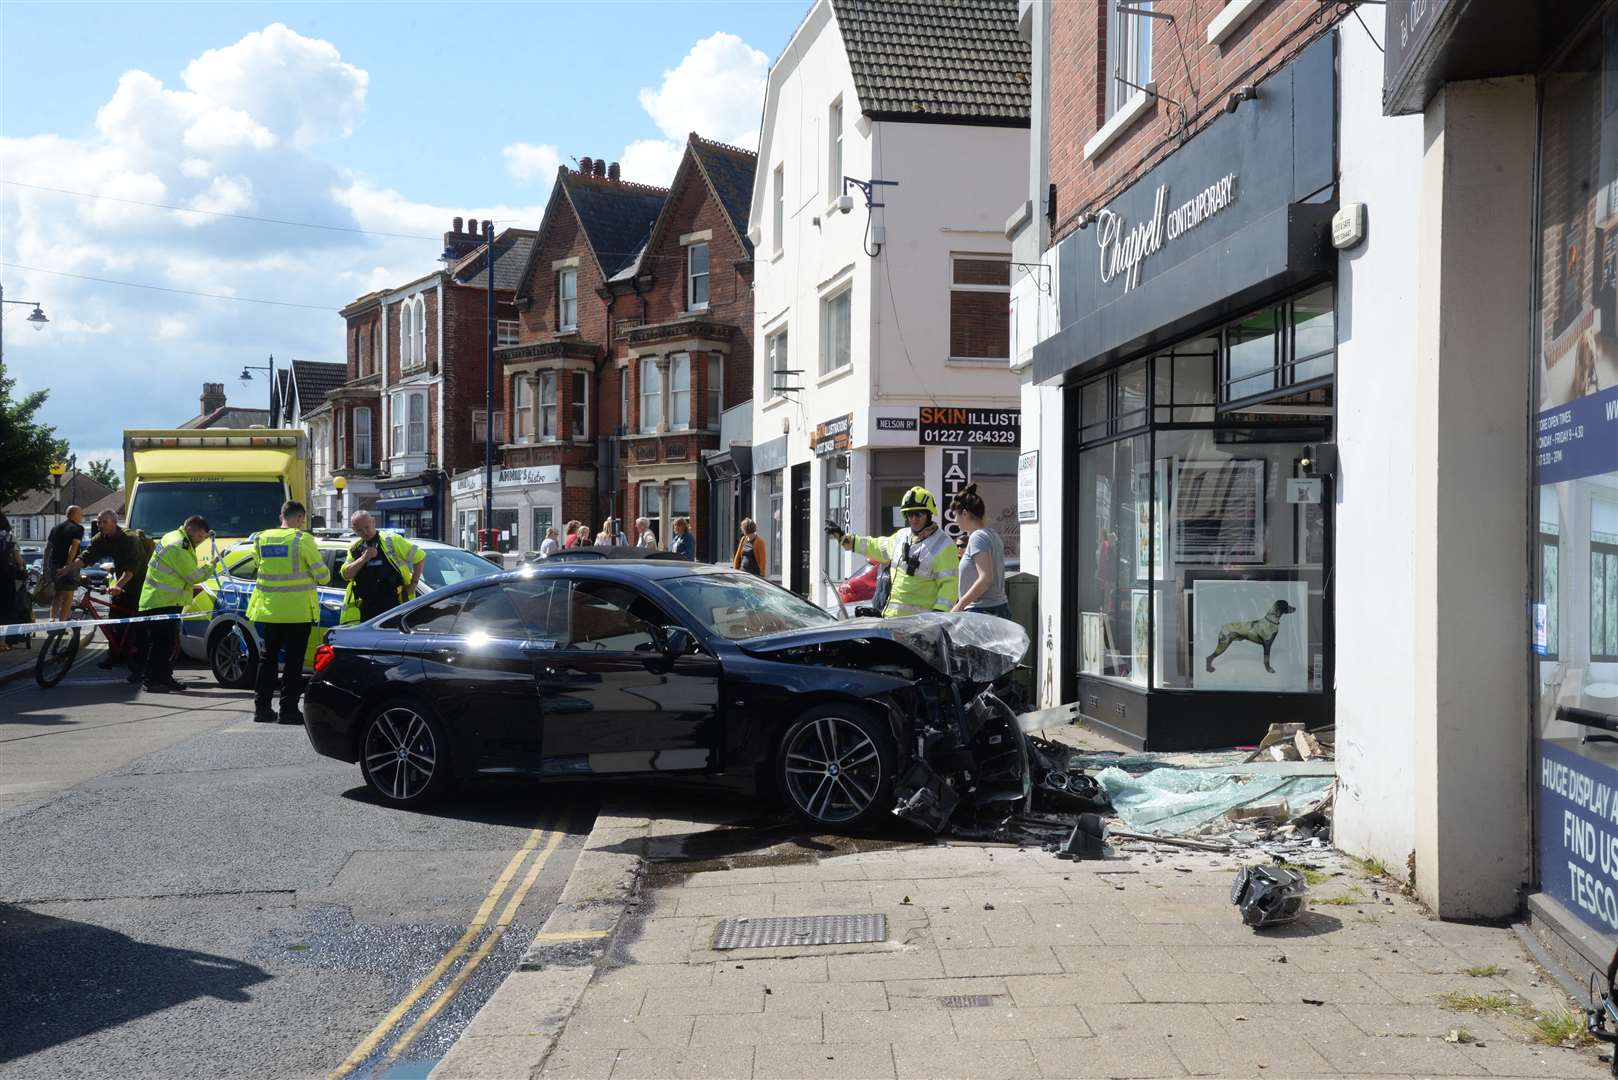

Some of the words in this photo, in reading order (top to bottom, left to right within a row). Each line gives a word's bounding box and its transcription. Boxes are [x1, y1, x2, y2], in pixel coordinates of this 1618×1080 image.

[1097, 183, 1165, 293] Chappell
[1167, 172, 1233, 240] CONTEMPORARY
[880, 419, 905, 429] NELSON
[920, 407, 966, 424] SKIN
[924, 429, 964, 442] 01227
[967, 430, 1016, 443] 264329
[498, 468, 527, 482] ANNIE'S
[1541, 756, 1568, 798] HUGE
[1569, 768, 1611, 820] DISPLAY
[1563, 809, 1596, 864] FIND
[1600, 830, 1618, 881] US
[1568, 860, 1618, 930] TESCO
